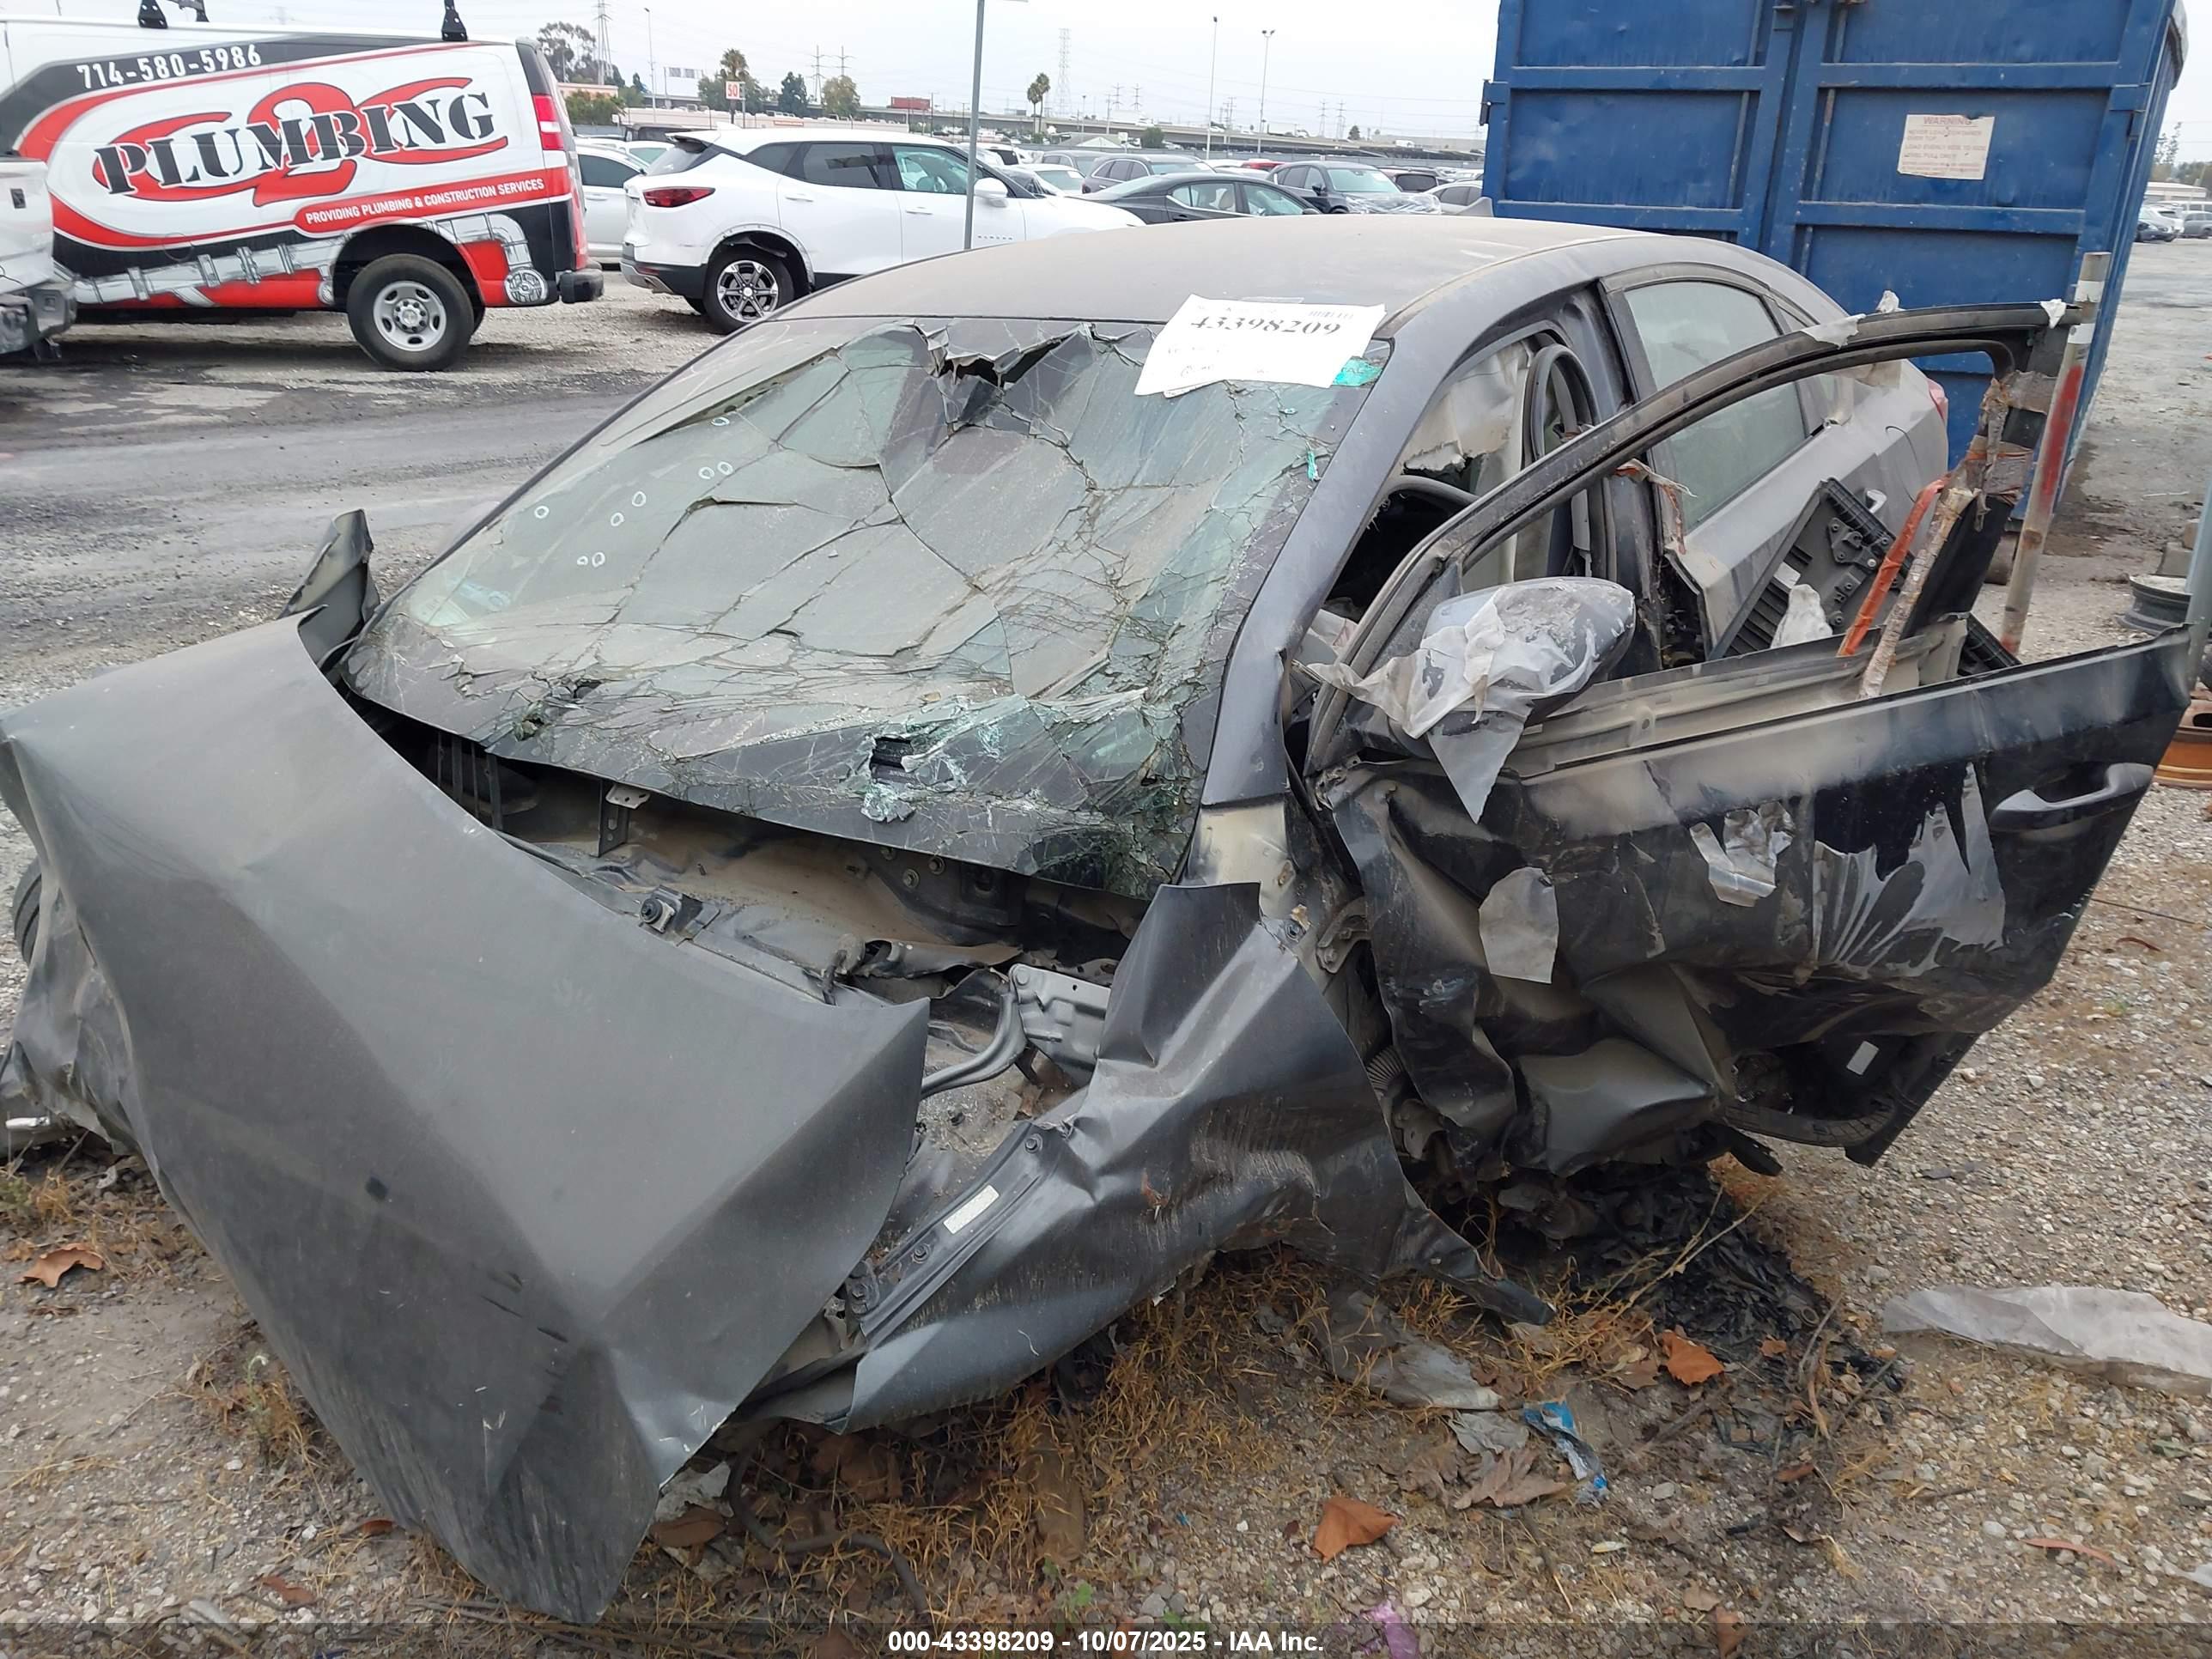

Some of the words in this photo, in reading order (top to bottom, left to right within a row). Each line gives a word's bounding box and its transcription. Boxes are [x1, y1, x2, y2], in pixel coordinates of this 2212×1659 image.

[76, 44, 261, 88] 714-580-5986
[94, 92, 496, 195] PLUMBING
[305, 205, 361, 225] PROVIDING
[362, 197, 413, 216] PLUMBING
[415, 197, 423, 207] &
[423, 185, 496, 207] CONSTRUCTION
[498, 178, 544, 196] SERVICES
[1191, 316, 1341, 336] 43398209
